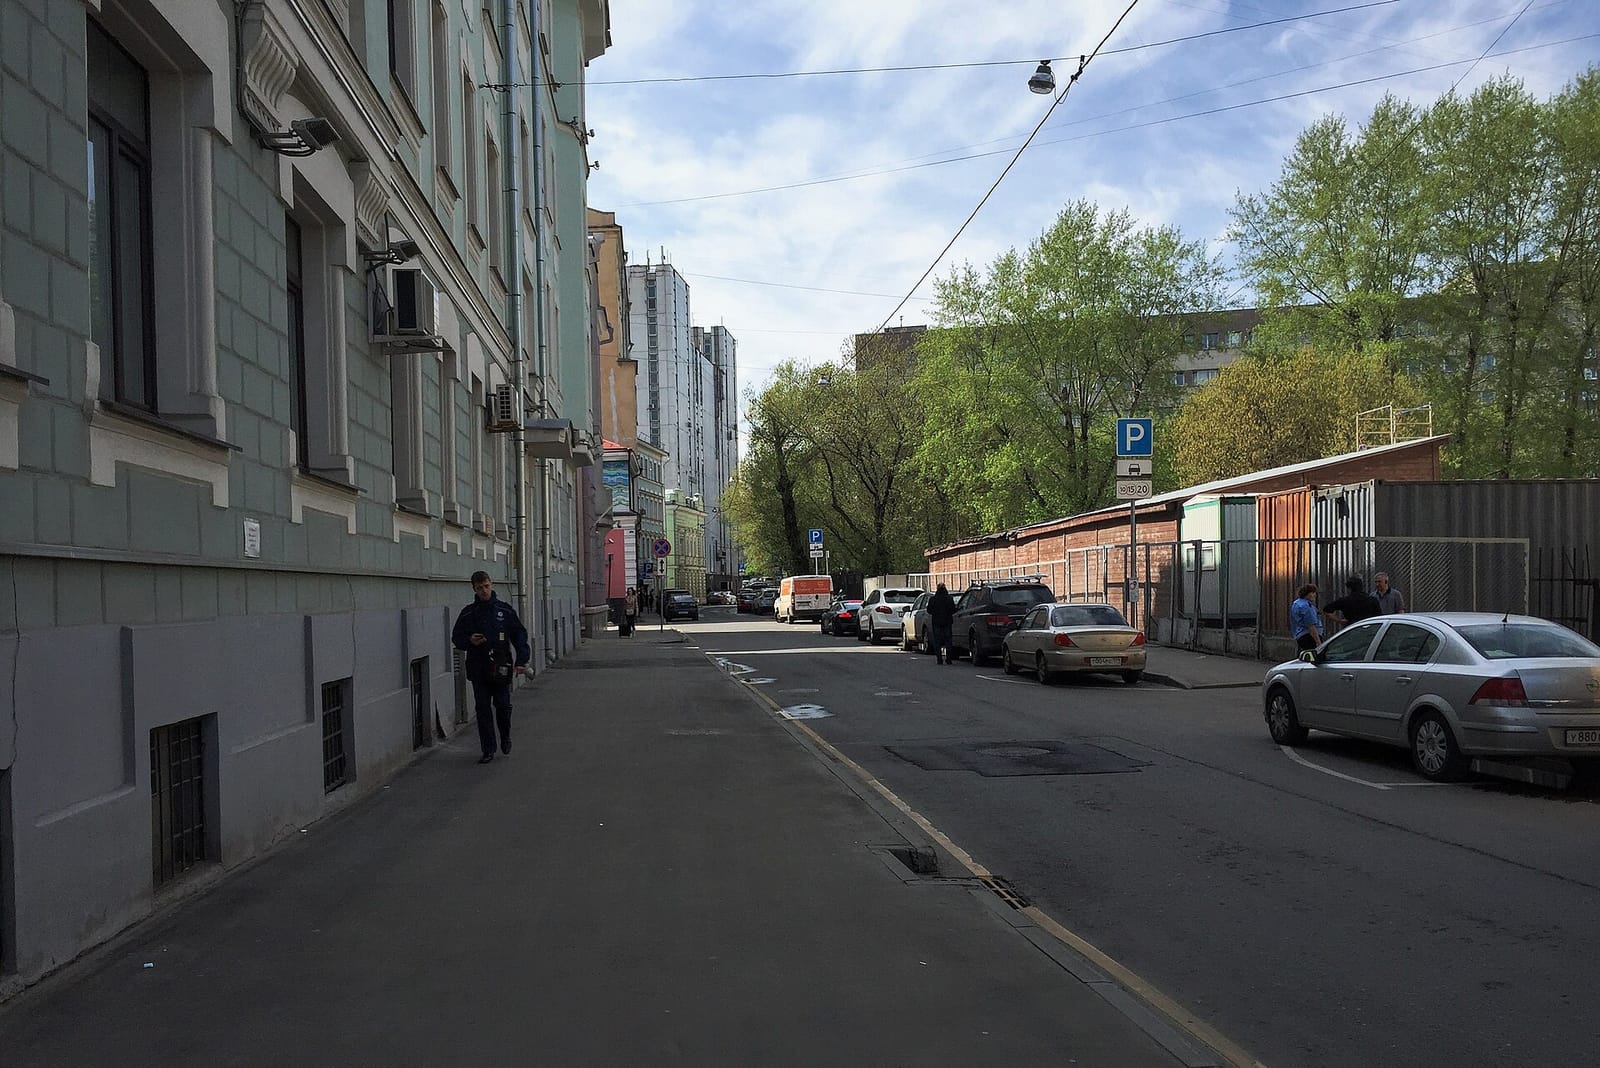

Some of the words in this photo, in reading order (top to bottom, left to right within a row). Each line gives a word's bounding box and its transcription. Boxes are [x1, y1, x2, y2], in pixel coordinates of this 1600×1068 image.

[1126, 423, 1145, 451] P
[1127, 485, 1135, 493] 15
[1137, 485, 1148, 494] 20
[812, 531, 820, 542] P
[1570, 731, 1600, 743] У880
